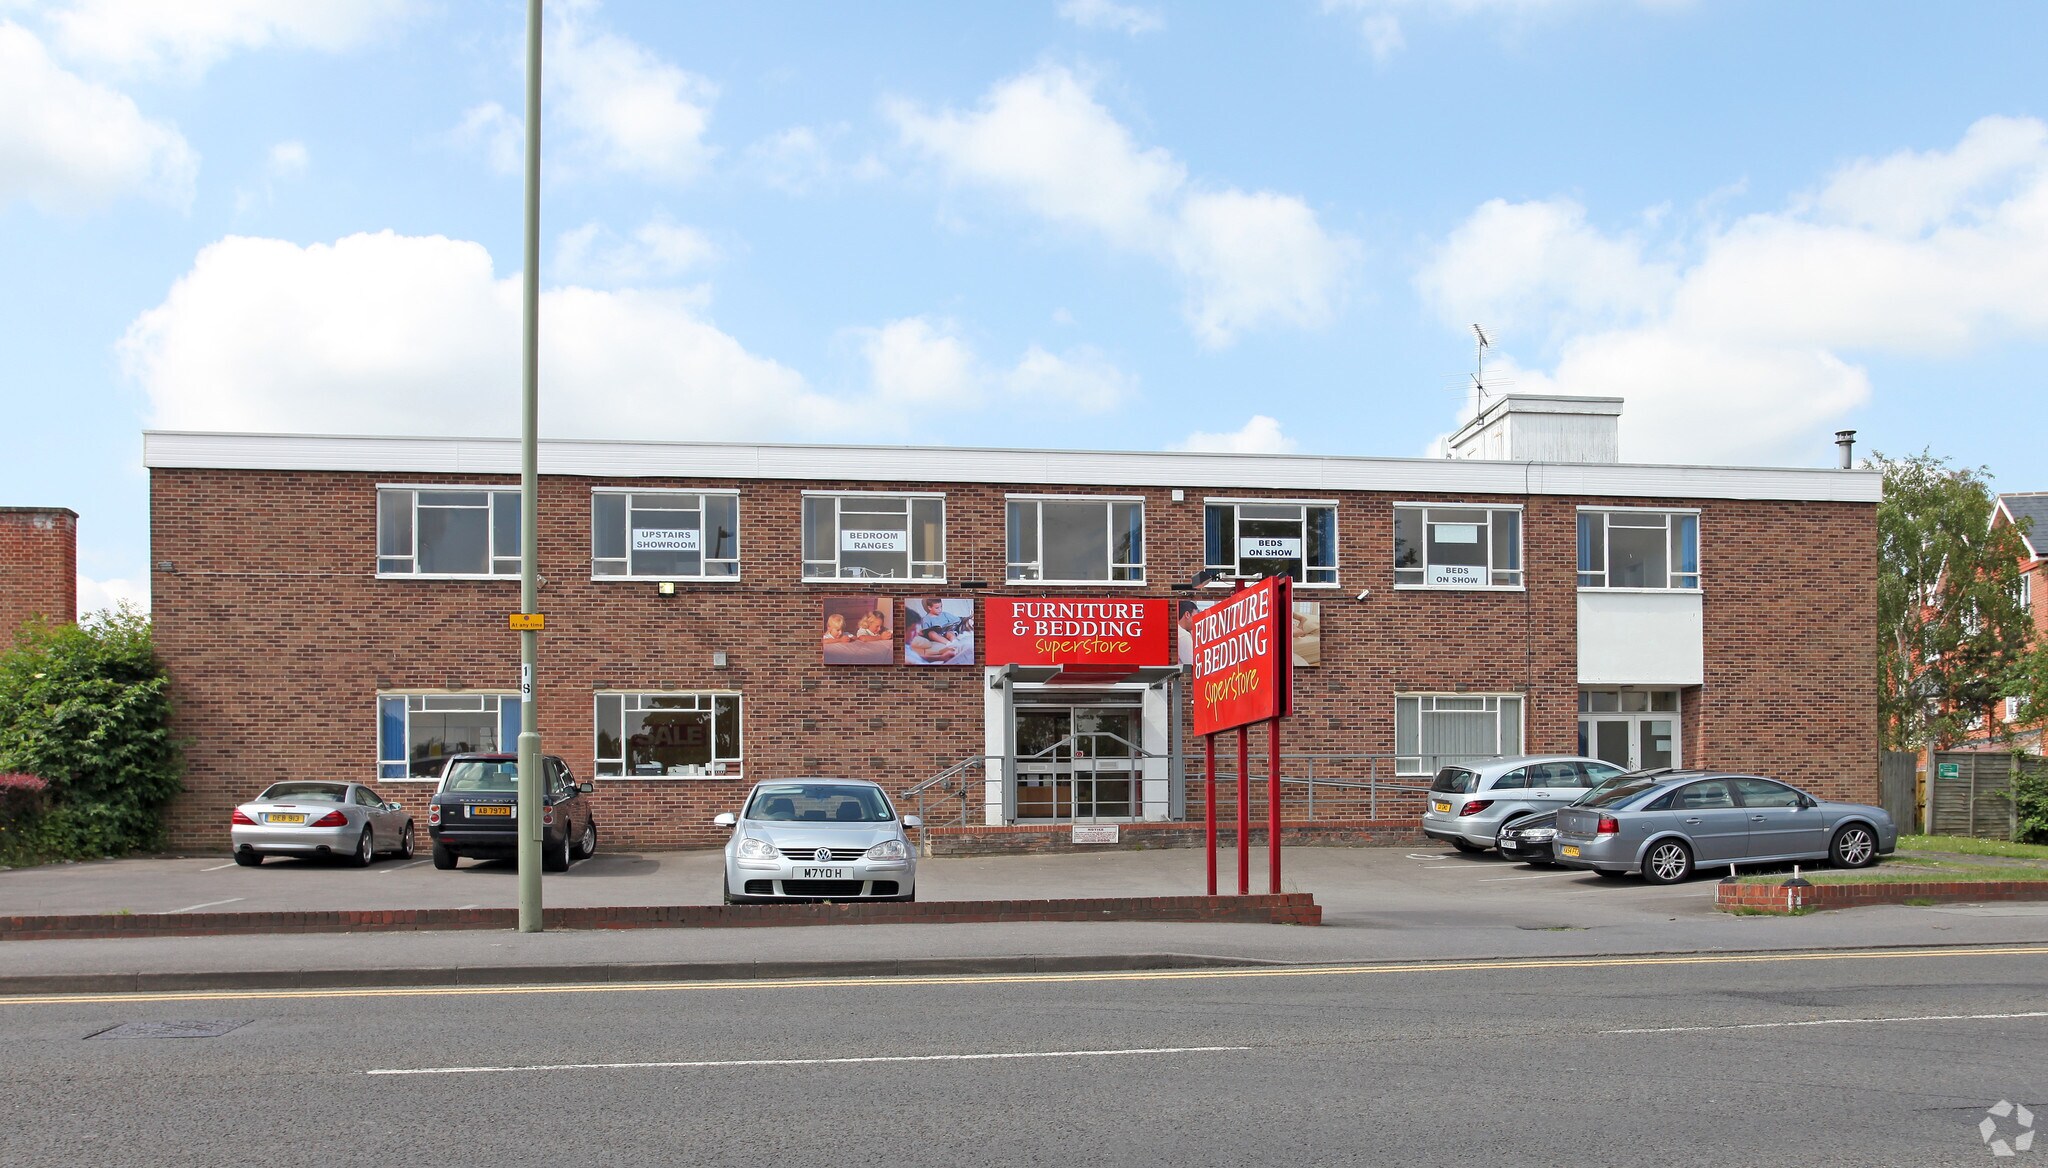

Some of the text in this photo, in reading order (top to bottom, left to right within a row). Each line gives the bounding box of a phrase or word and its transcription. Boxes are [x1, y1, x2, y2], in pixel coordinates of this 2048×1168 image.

[641, 531, 691, 539] UPSTAIRS
[849, 532, 898, 540] BEDROOM
[1258, 539, 1283, 547] BEDS
[636, 541, 696, 549] SHOWROOM
[1011, 602, 1145, 619] FURNITURE
[1194, 588, 1269, 649] FURNITURE
[1012, 620, 1143, 637] & BEDDING
[1035, 635, 1131, 662] superstore
[1195, 625, 1268, 680] & BEDDING
[1204, 661, 1260, 722] superstore
[632, 725, 703, 746] SALE
